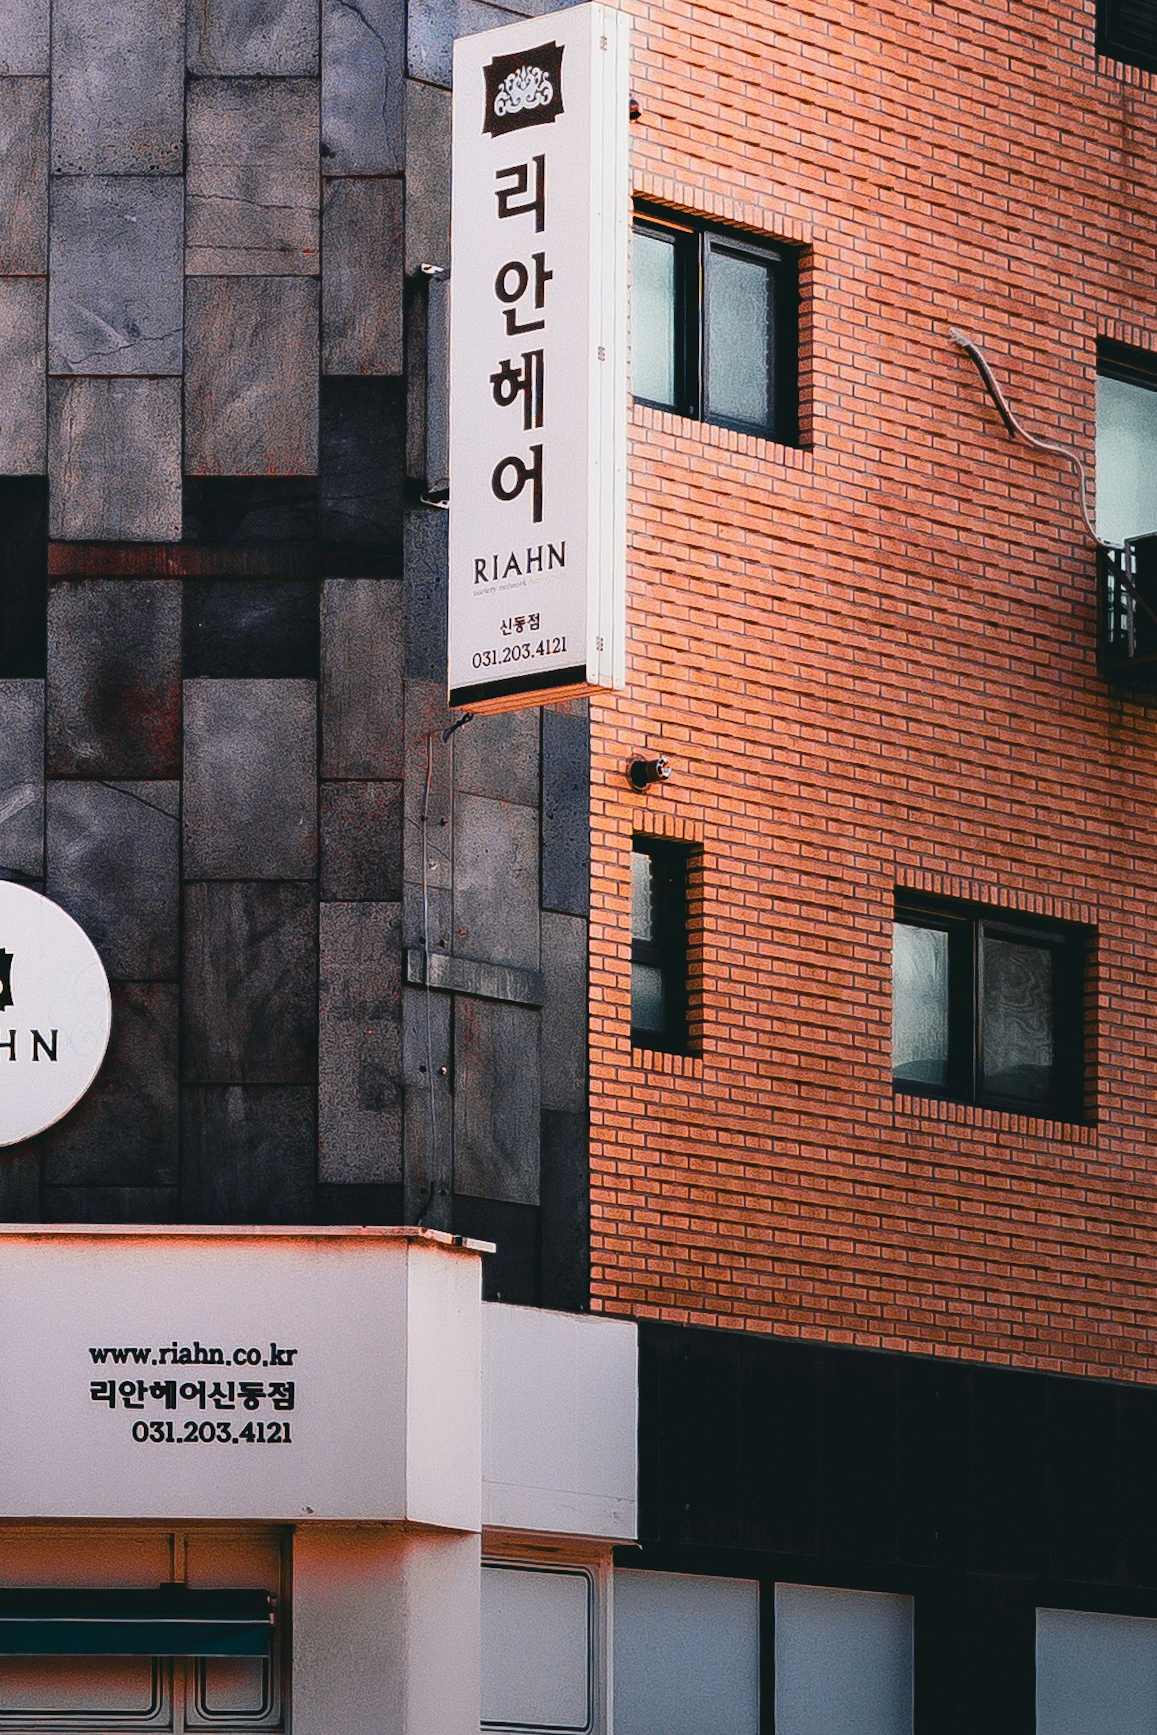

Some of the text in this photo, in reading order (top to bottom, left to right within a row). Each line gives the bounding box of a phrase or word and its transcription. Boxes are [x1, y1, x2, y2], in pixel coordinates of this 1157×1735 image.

[490, 153, 553, 524] 리안헤어
[473, 540, 567, 585] RIAHN
[499, 612, 540, 636] 신동점
[471, 636, 568, 669] 031.203.4121
[89, 1341, 298, 1367] www.riahn.co.kr
[89, 1380, 296, 1411] 리안헤어신동점
[131, 1420, 293, 1444] 031.203.4121
